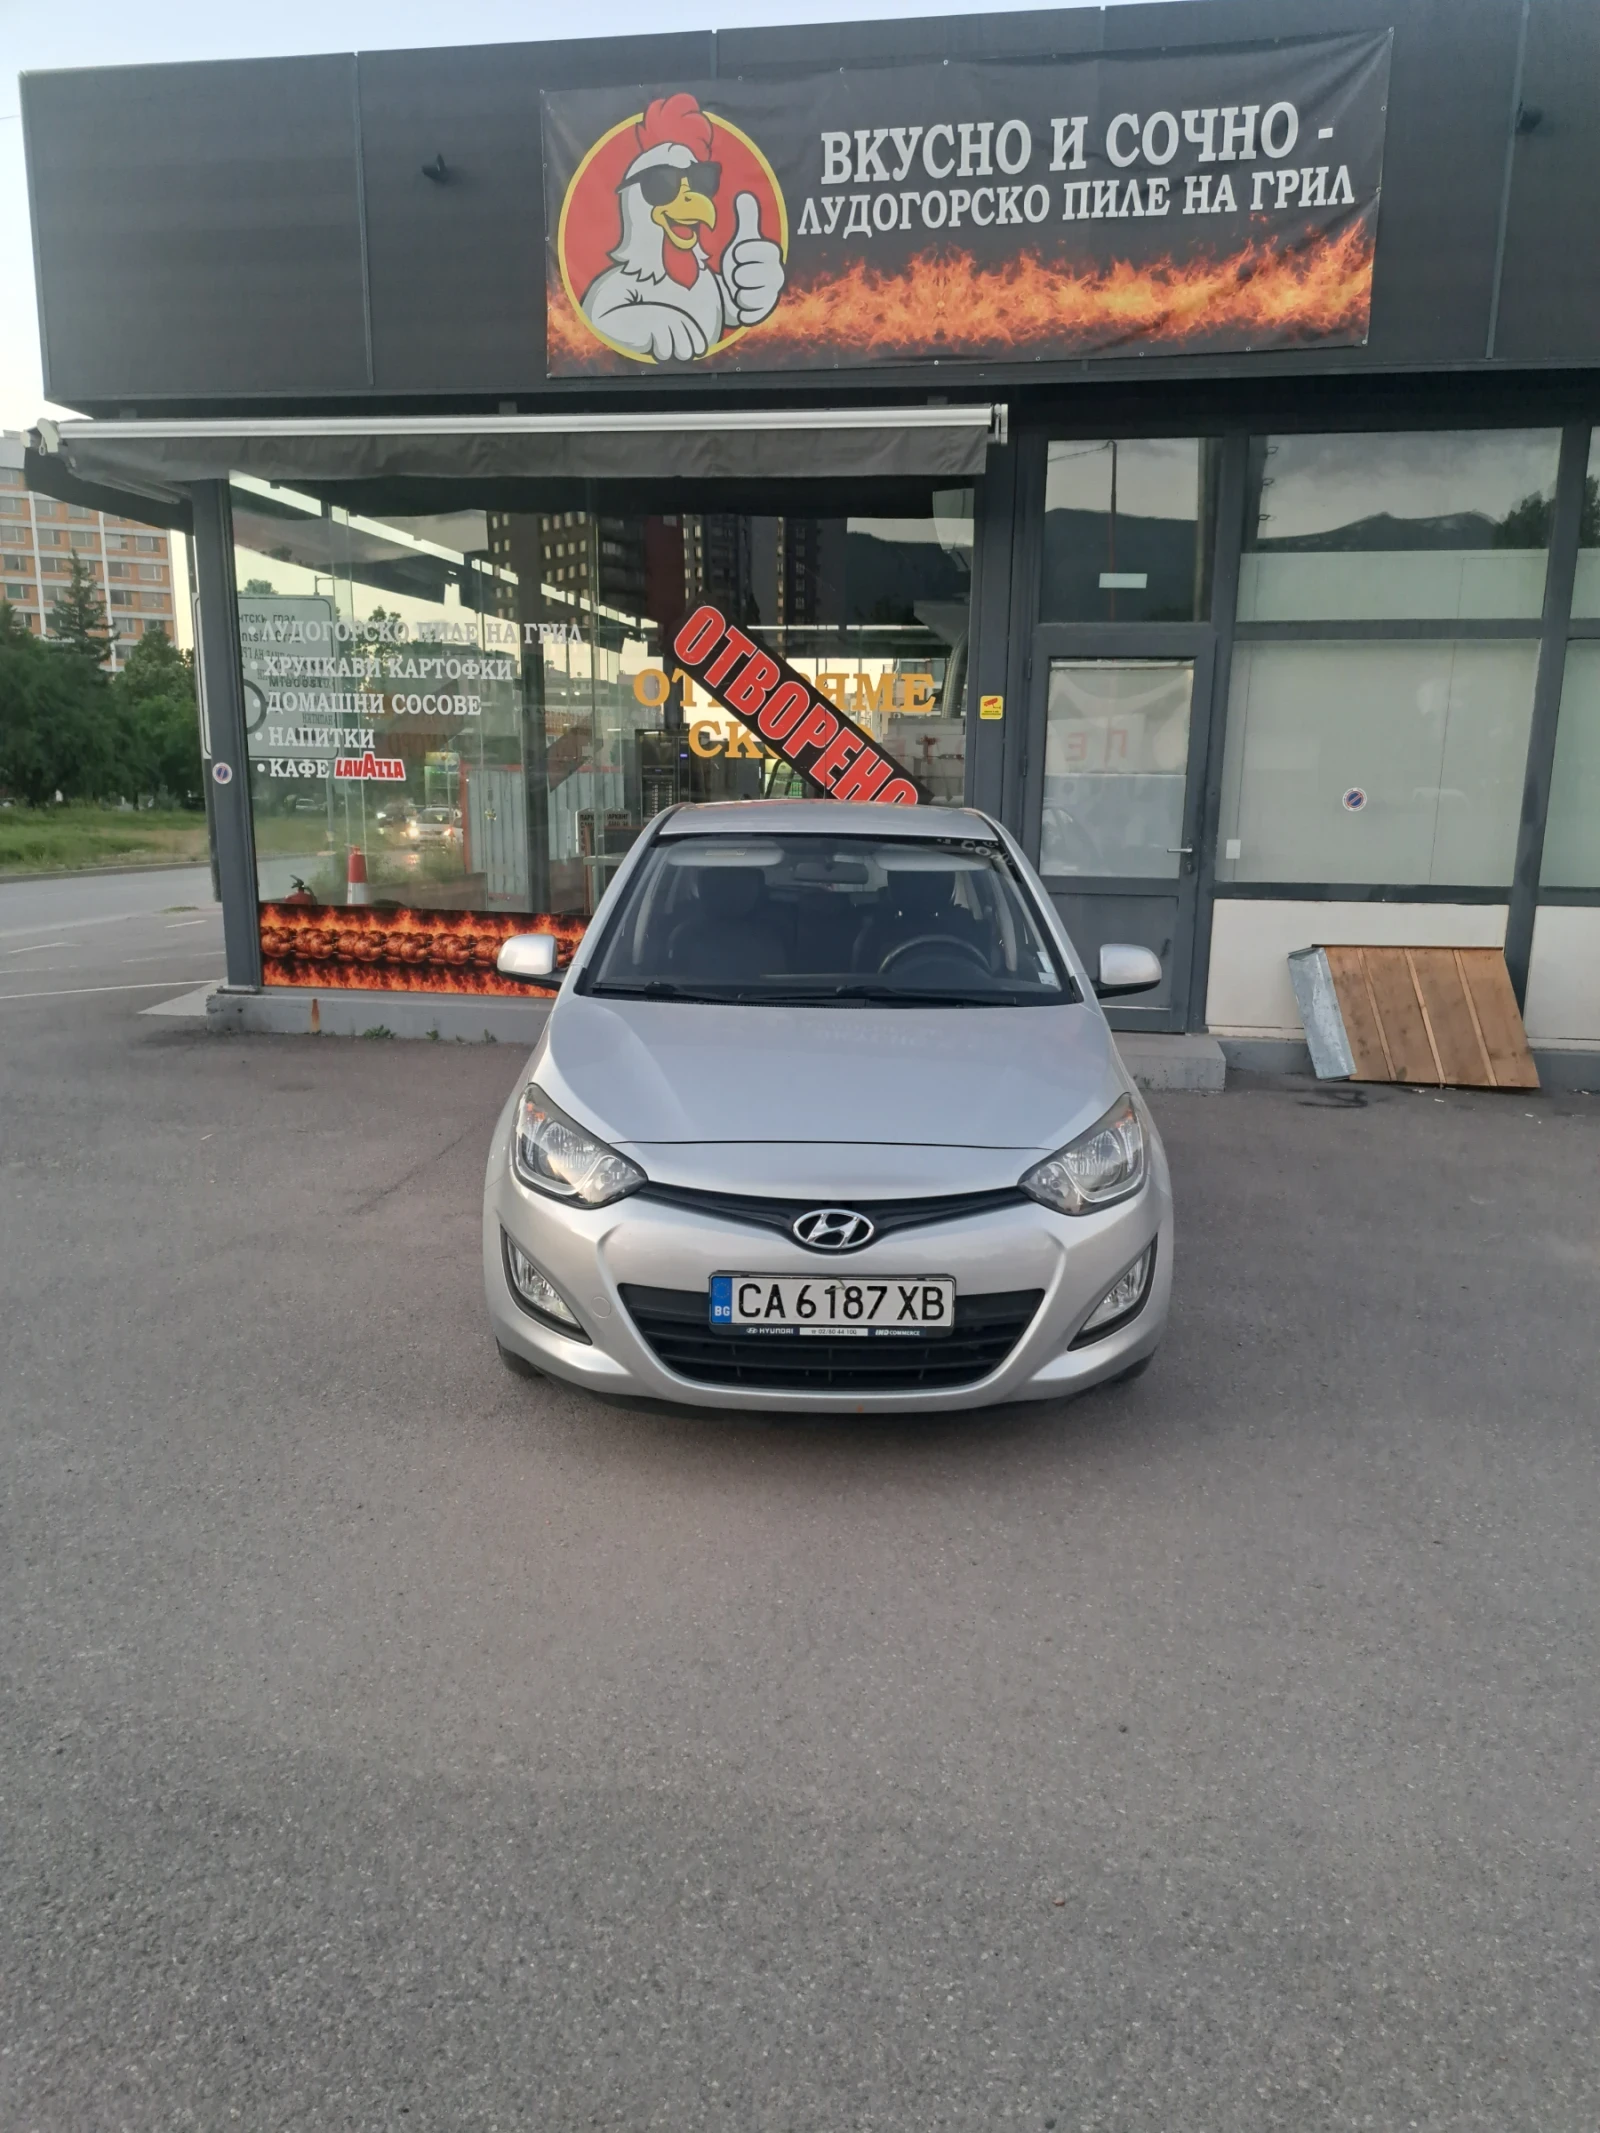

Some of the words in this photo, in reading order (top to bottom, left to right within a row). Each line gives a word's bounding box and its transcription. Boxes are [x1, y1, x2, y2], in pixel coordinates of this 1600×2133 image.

[821, 119, 1031, 184] ВКУСНО
[1049, 116, 1089, 172] И
[1106, 102, 1299, 167] СОЧНО
[797, 184, 1050, 239] ЛУДОГОРСКО
[1063, 177, 1171, 220] ПИЛЕ
[1182, 174, 1234, 214] НА
[1251, 165, 1355, 211] ГРИЛ
[262, 621, 409, 644] ЛУДОГОРСКО
[417, 622, 478, 643] ПИЛЕ
[486, 623, 517, 643] НА
[524, 624, 583, 644] ГРИЛ
[264, 656, 381, 678] ХРУПКАВИ
[389, 658, 513, 680] КАРТОФКИ
[266, 692, 385, 714] ДОМАШНИ
[391, 694, 482, 715] СОСОВЕ
[633, 668, 936, 713] ОТЯМЕ
[268, 727, 375, 748] НАПИТКИ
[269, 759, 329, 778] КАФЕ
[335, 752, 405, 780] LAVAZZA
[714, 1305, 731, 1317] BG
[738, 1283, 786, 1319] CA
[796, 1284, 888, 1320] 6187
[896, 1286, 945, 1321] XB
